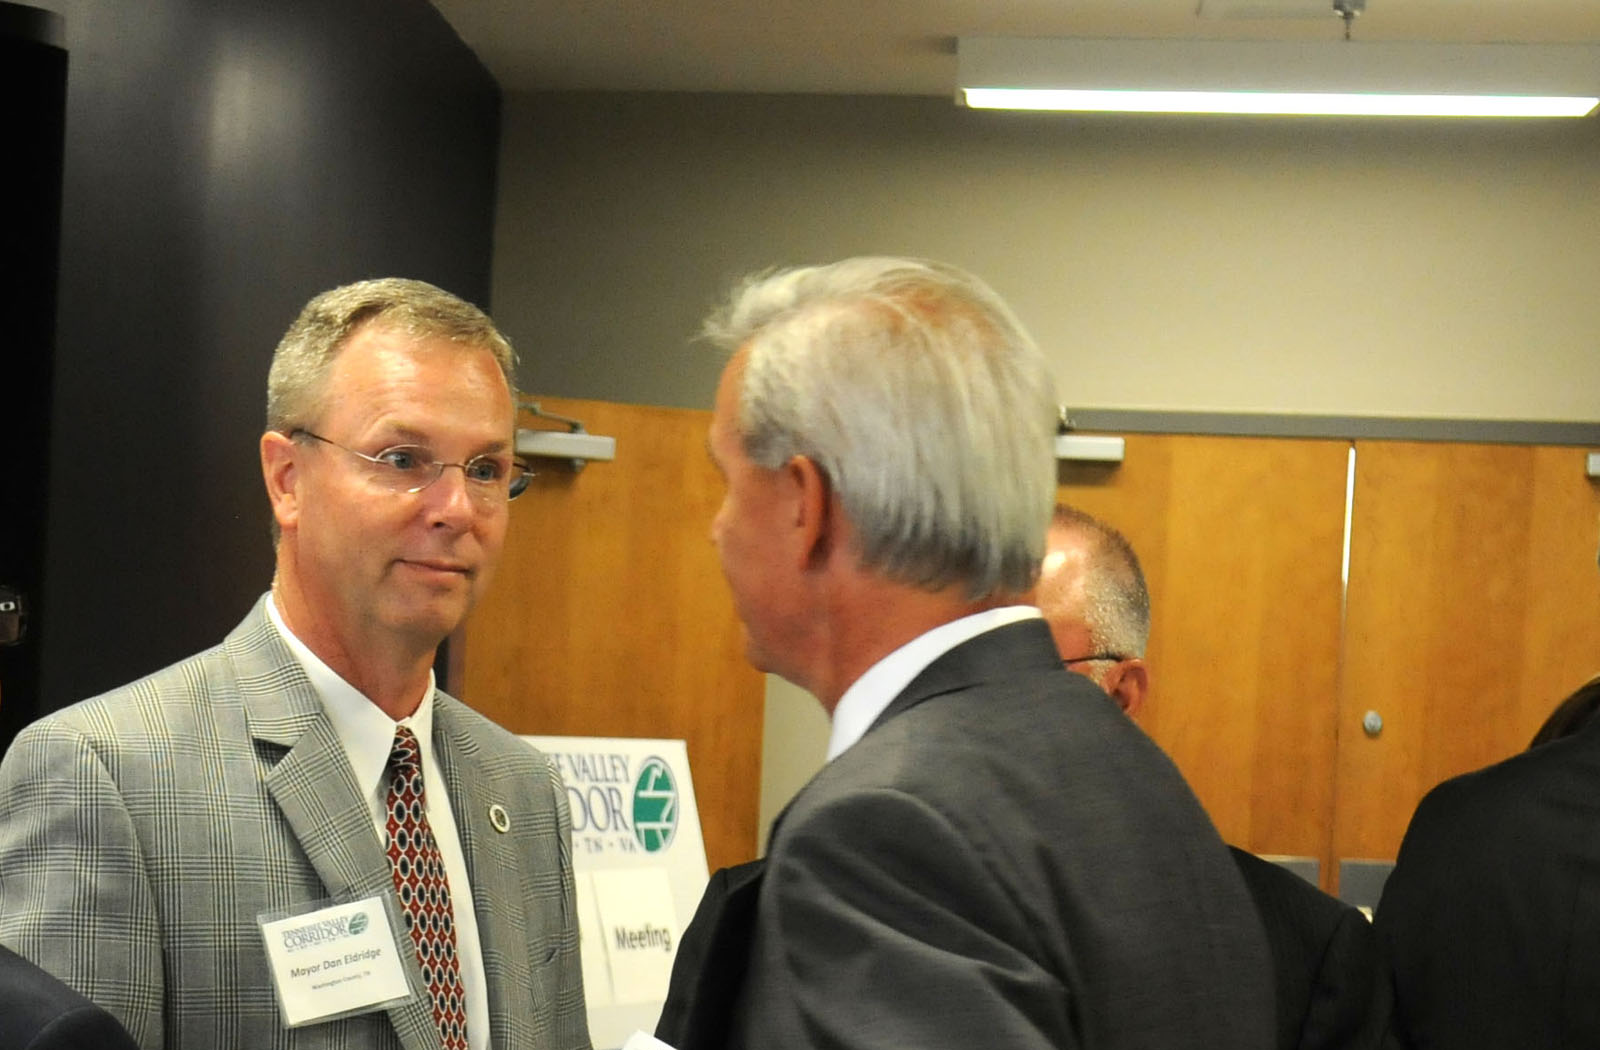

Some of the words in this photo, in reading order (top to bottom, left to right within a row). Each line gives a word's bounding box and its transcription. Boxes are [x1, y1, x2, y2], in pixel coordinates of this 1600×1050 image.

[566, 754, 630, 782] VALLEY
[283, 926, 347, 949] CORRIDOR
[614, 923, 672, 952] Meeting
[291, 964, 320, 978] Mayor
[323, 959, 342, 970] Dan
[344, 948, 381, 964] Eldridge
